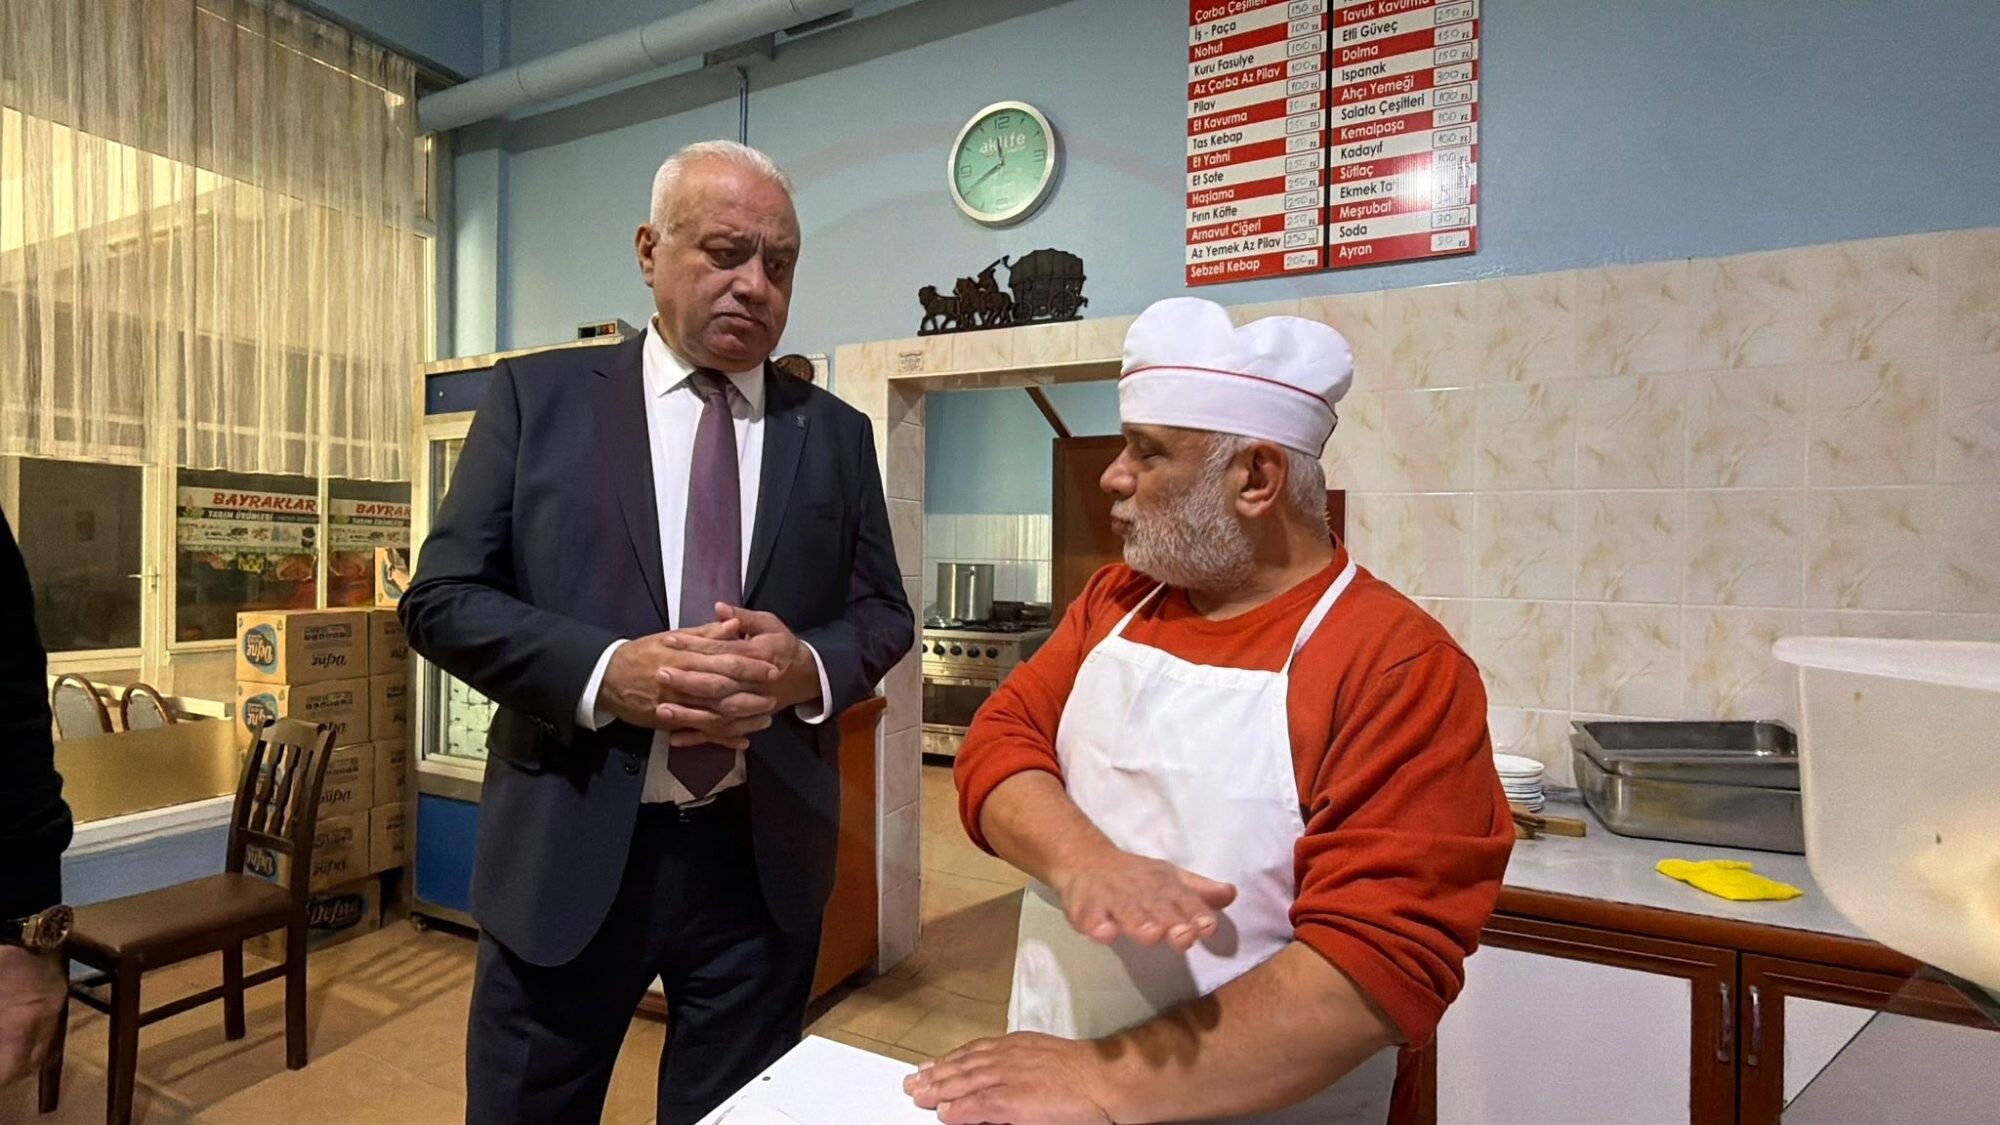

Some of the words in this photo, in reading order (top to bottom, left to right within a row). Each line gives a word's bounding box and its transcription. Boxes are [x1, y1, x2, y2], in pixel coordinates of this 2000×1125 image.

[1194, 5, 1226, 24] Çorba
[1342, 6, 1376, 23] Tavuk
[1211, 21, 1237, 36] Paça
[1291, 22, 1310, 33] 100
[1342, 27, 1358, 42] Etli
[1360, 21, 1399, 37] Güveç
[1438, 28, 1460, 37] 150
[1193, 40, 1223, 59] Nohut
[1291, 41, 1310, 53] 100
[1342, 45, 1379, 62] Dolma
[1438, 49, 1458, 60] 150
[1194, 64, 1216, 77] Kuru
[1217, 54, 1255, 70] Fasulye
[1341, 62, 1386, 81] Ispanak
[1193, 83, 1206, 95] Az
[1207, 76, 1239, 93] Çorba
[1241, 73, 1254, 84] Az
[1256, 67, 1281, 80] Pilav
[1370, 75, 1414, 94] Yemeği
[1193, 100, 1216, 113] Pilav
[1341, 105, 1376, 120] Salata
[1378, 93, 1425, 115] Çeşitleri
[993, 115, 1011, 130] 12
[1193, 120, 1202, 132] Et
[1203, 112, 1248, 130] Kavurma
[1340, 120, 1405, 140] Kemalpaşa
[1192, 138, 1208, 150] Tas
[1210, 131, 1243, 147] Kebap
[1033, 148, 1045, 162] 3
[1340, 140, 1384, 160] Kadayıf
[1192, 157, 1201, 169] Et
[1203, 150, 1231, 166] Yahni
[960, 164, 973, 178] 9
[1192, 175, 1201, 186] Et
[1203, 171, 1224, 184] Sote
[1340, 164, 1374, 180] Sütlaç
[1191, 189, 1235, 205] Haşlama
[1340, 182, 1380, 199] Ekmek
[1191, 211, 1210, 223] Fırın
[1212, 206, 1238, 219] Köfte
[1339, 199, 1393, 219] Meşrubat
[1191, 221, 1229, 241] Arnavut
[1230, 219, 1262, 236] Ciğeri
[1339, 224, 1368, 238] Soda
[1191, 247, 1203, 259] Az
[1205, 241, 1240, 256] Yemek
[1241, 240, 1255, 251] Az
[1257, 237, 1281, 249] Pilav
[1338, 244, 1373, 260] Ayran
[1190, 261, 1226, 278] Sebzeli
[1226, 259, 1261, 276] Kebap
[213, 491, 317, 512] BAYRAKLAR
[311, 652, 347, 669] Defne
